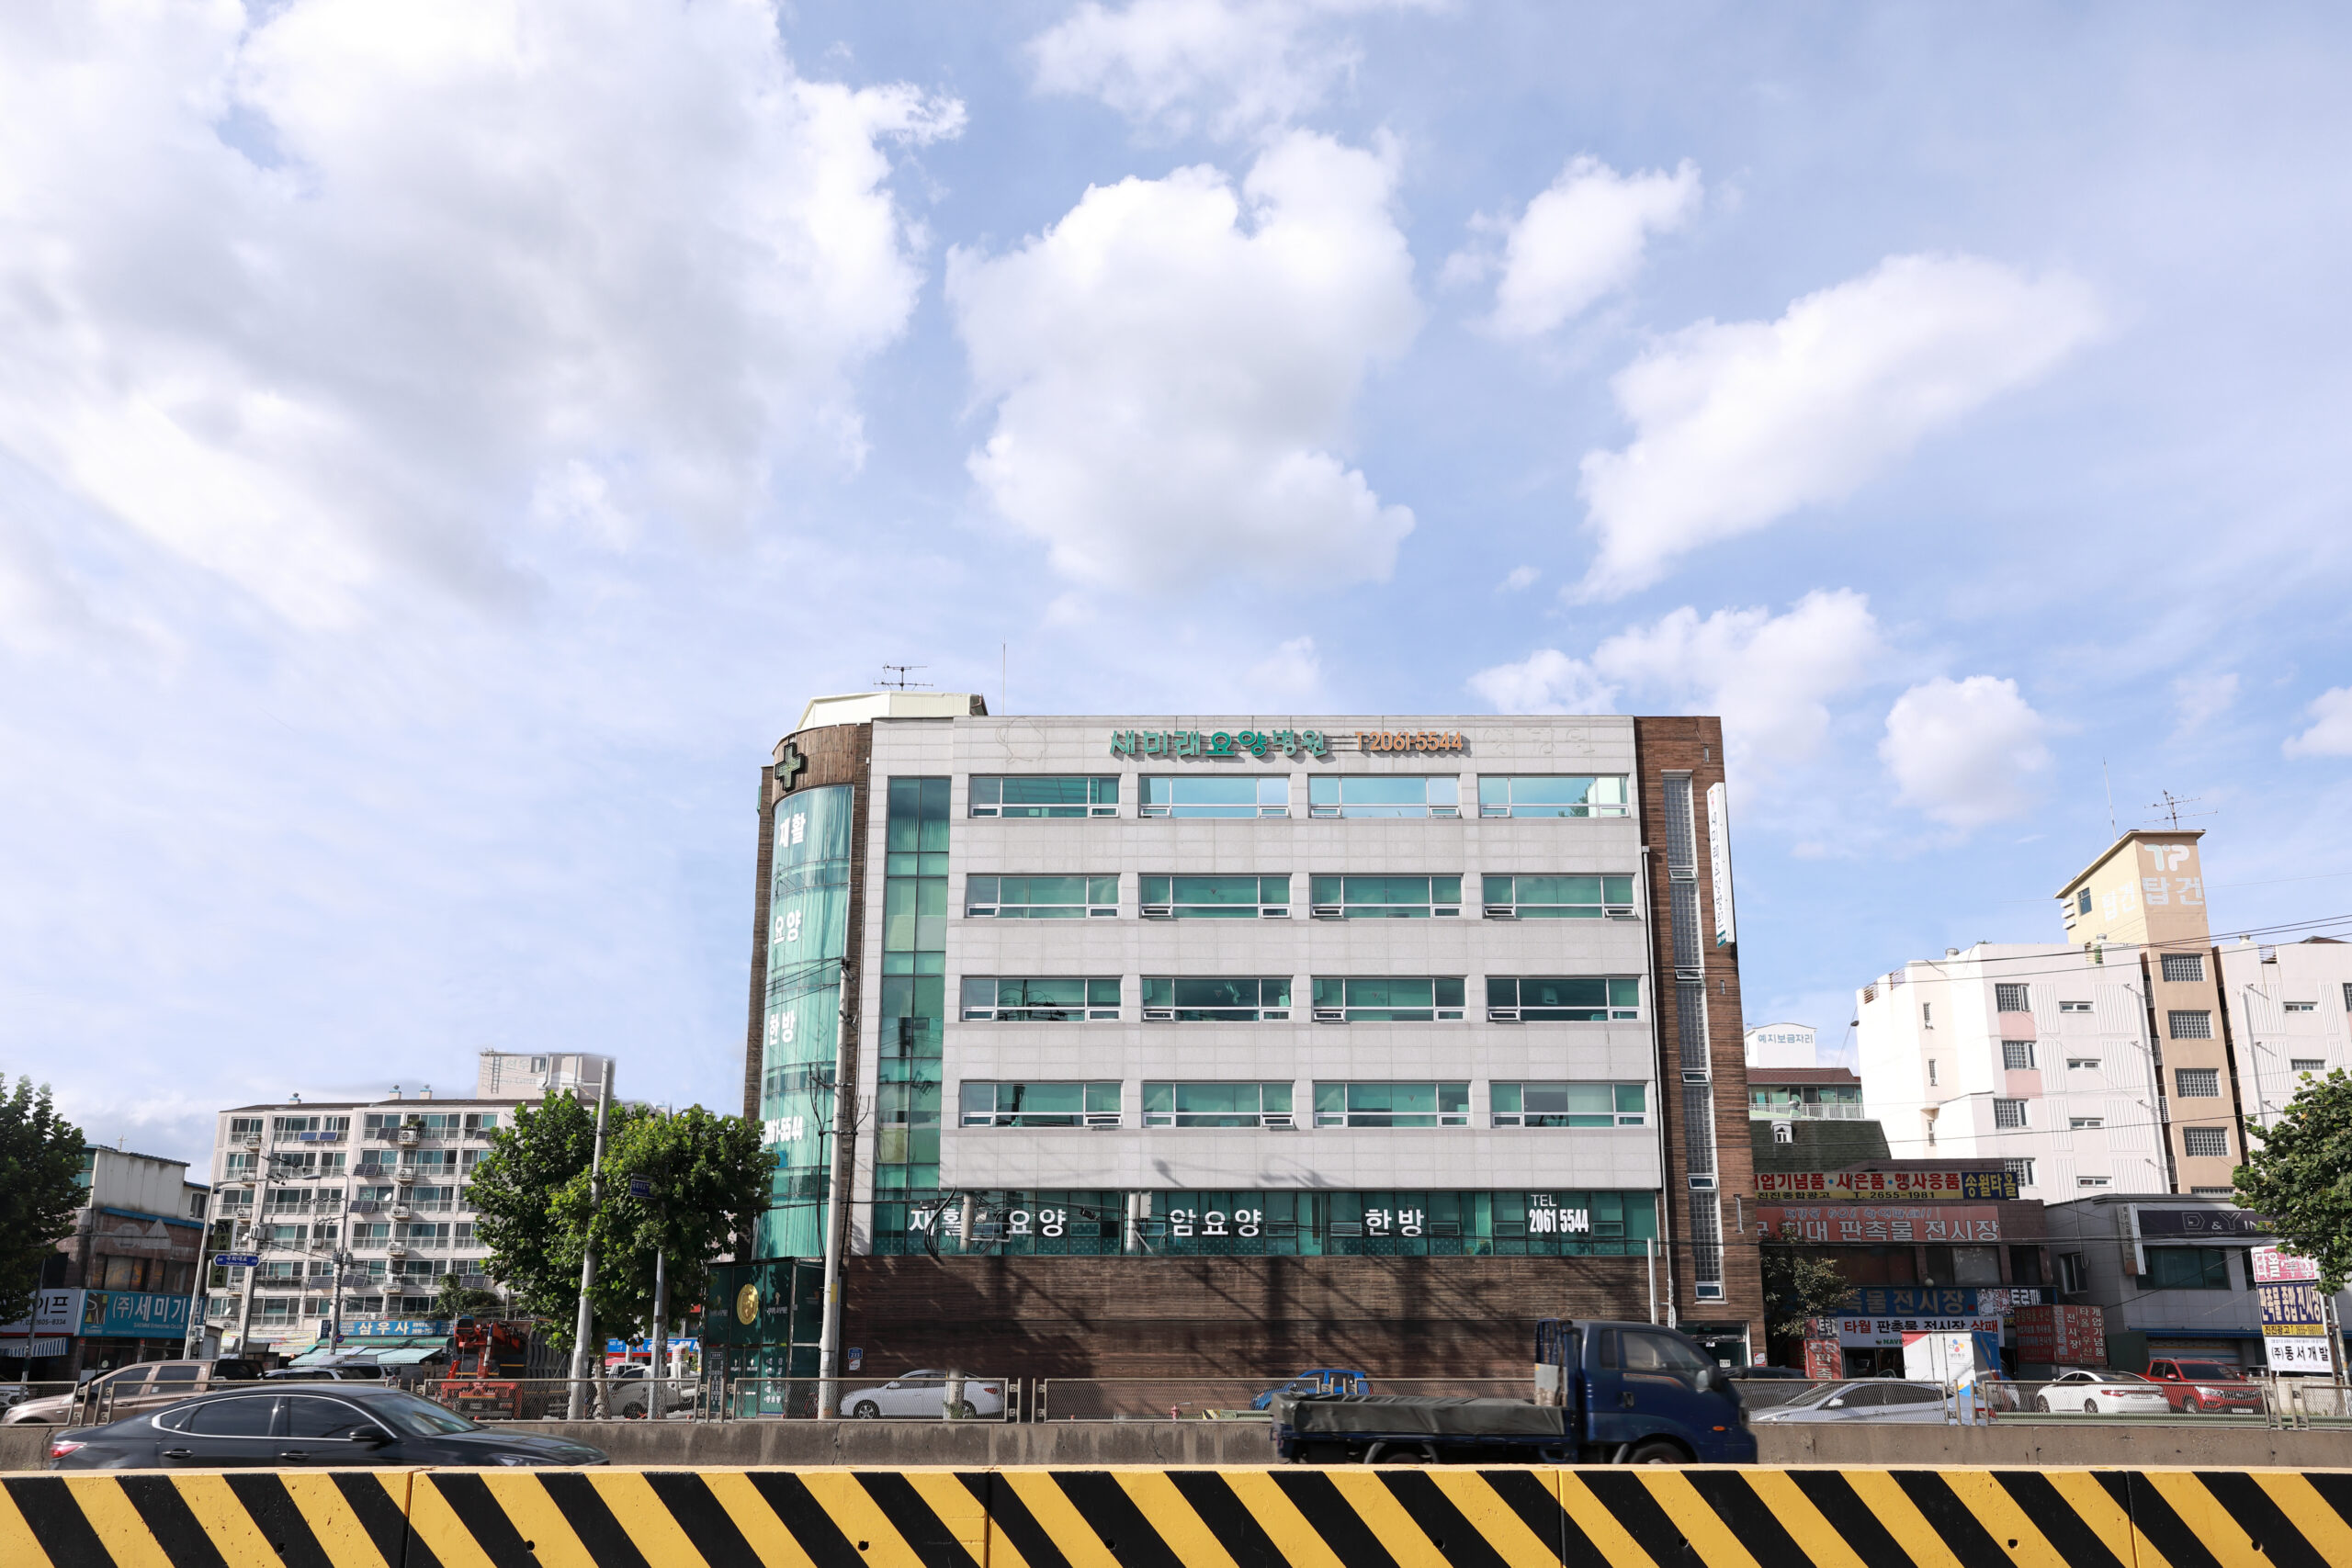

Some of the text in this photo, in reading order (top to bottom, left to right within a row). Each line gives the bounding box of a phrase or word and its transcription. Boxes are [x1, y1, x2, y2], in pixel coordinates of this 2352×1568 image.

[778, 812, 806, 847] 재활
[2142, 876, 2205, 905] 탑건
[773, 909, 802, 943] 요양
[769, 1010, 796, 1046] 한방
[1754, 1173, 1825, 1190] 업기념품
[1964, 1173, 2017, 1197] 송월타올
[1531, 1194, 1557, 1207] TEL
[1006, 1209, 1067, 1237] 요양
[1170, 1209, 1262, 1237] 암요양
[1365, 1208, 1424, 1237] 한방
[1529, 1209, 1589, 1233] 2061 5544
[1838, 1220, 1913, 1242] 판촉물
[1925, 1220, 1999, 1242] 전시장
[38, 1296, 69, 1314] 이프
[358, 1322, 410, 1336] 삼우사
[1844, 1320, 1871, 1333] 타월
